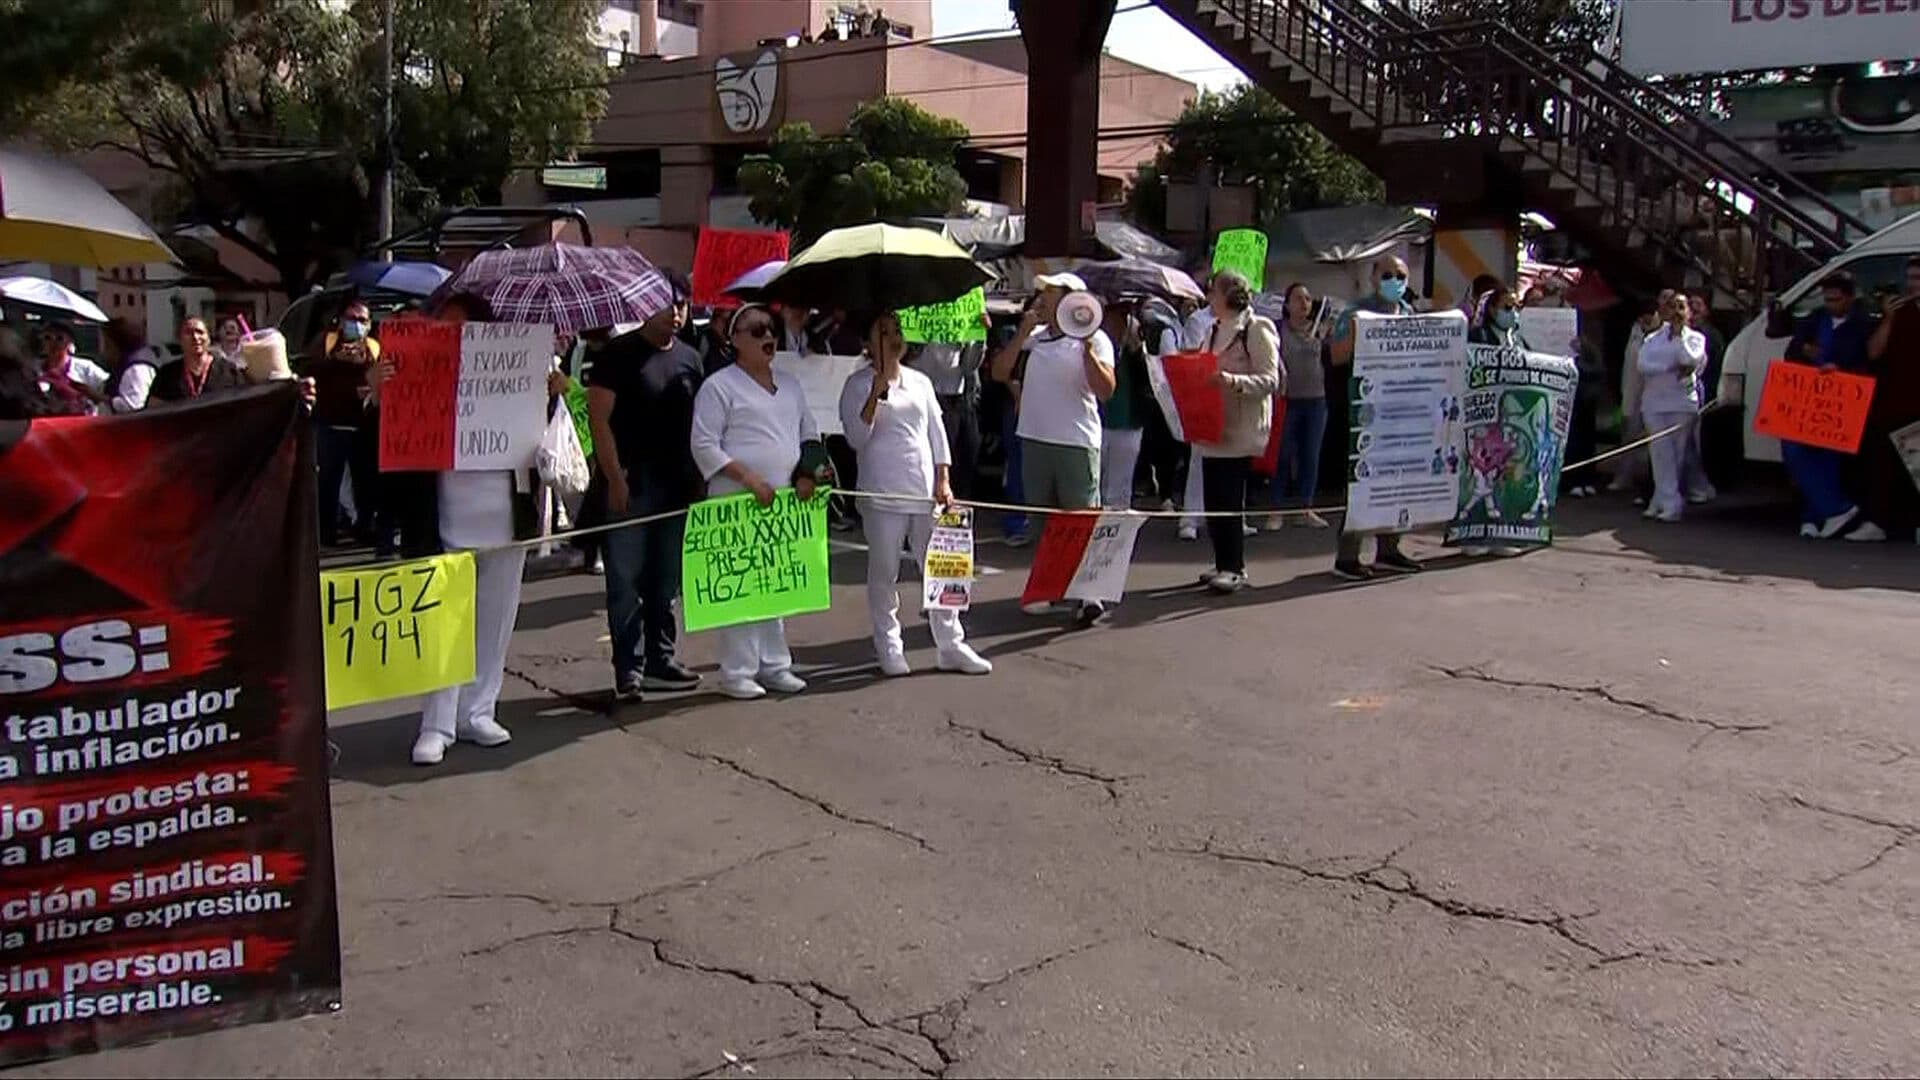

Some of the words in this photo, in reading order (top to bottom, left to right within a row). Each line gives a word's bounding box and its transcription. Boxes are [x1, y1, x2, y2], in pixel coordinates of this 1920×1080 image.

[1477, 348, 1499, 366] MIS
[1501, 349, 1524, 366] DOS
[460, 428, 509, 457] UNIDO
[691, 506, 711, 528] NI
[716, 501, 739, 524] UN
[751, 512, 812, 545] XXXVII
[705, 540, 797, 576] PRESENTE
[328, 566, 441, 625] HGZ
[695, 574, 751, 604] HGZ
[340, 616, 421, 667] 194
[5, 686, 242, 742] tabulador
[35, 721, 241, 775] inflación.
[59, 770, 249, 832] protesta:
[1, 845, 27, 866] a
[40, 835, 76, 860] la
[89, 804, 248, 849] espalda.
[2, 885, 96, 921] ción
[109, 855, 276, 912] sindical.
[0, 930, 24, 949] a
[36, 913, 114, 943] libre
[125, 889, 291, 929] expresión.
[63, 940, 244, 993] personal
[26, 981, 222, 1026] miserable.
